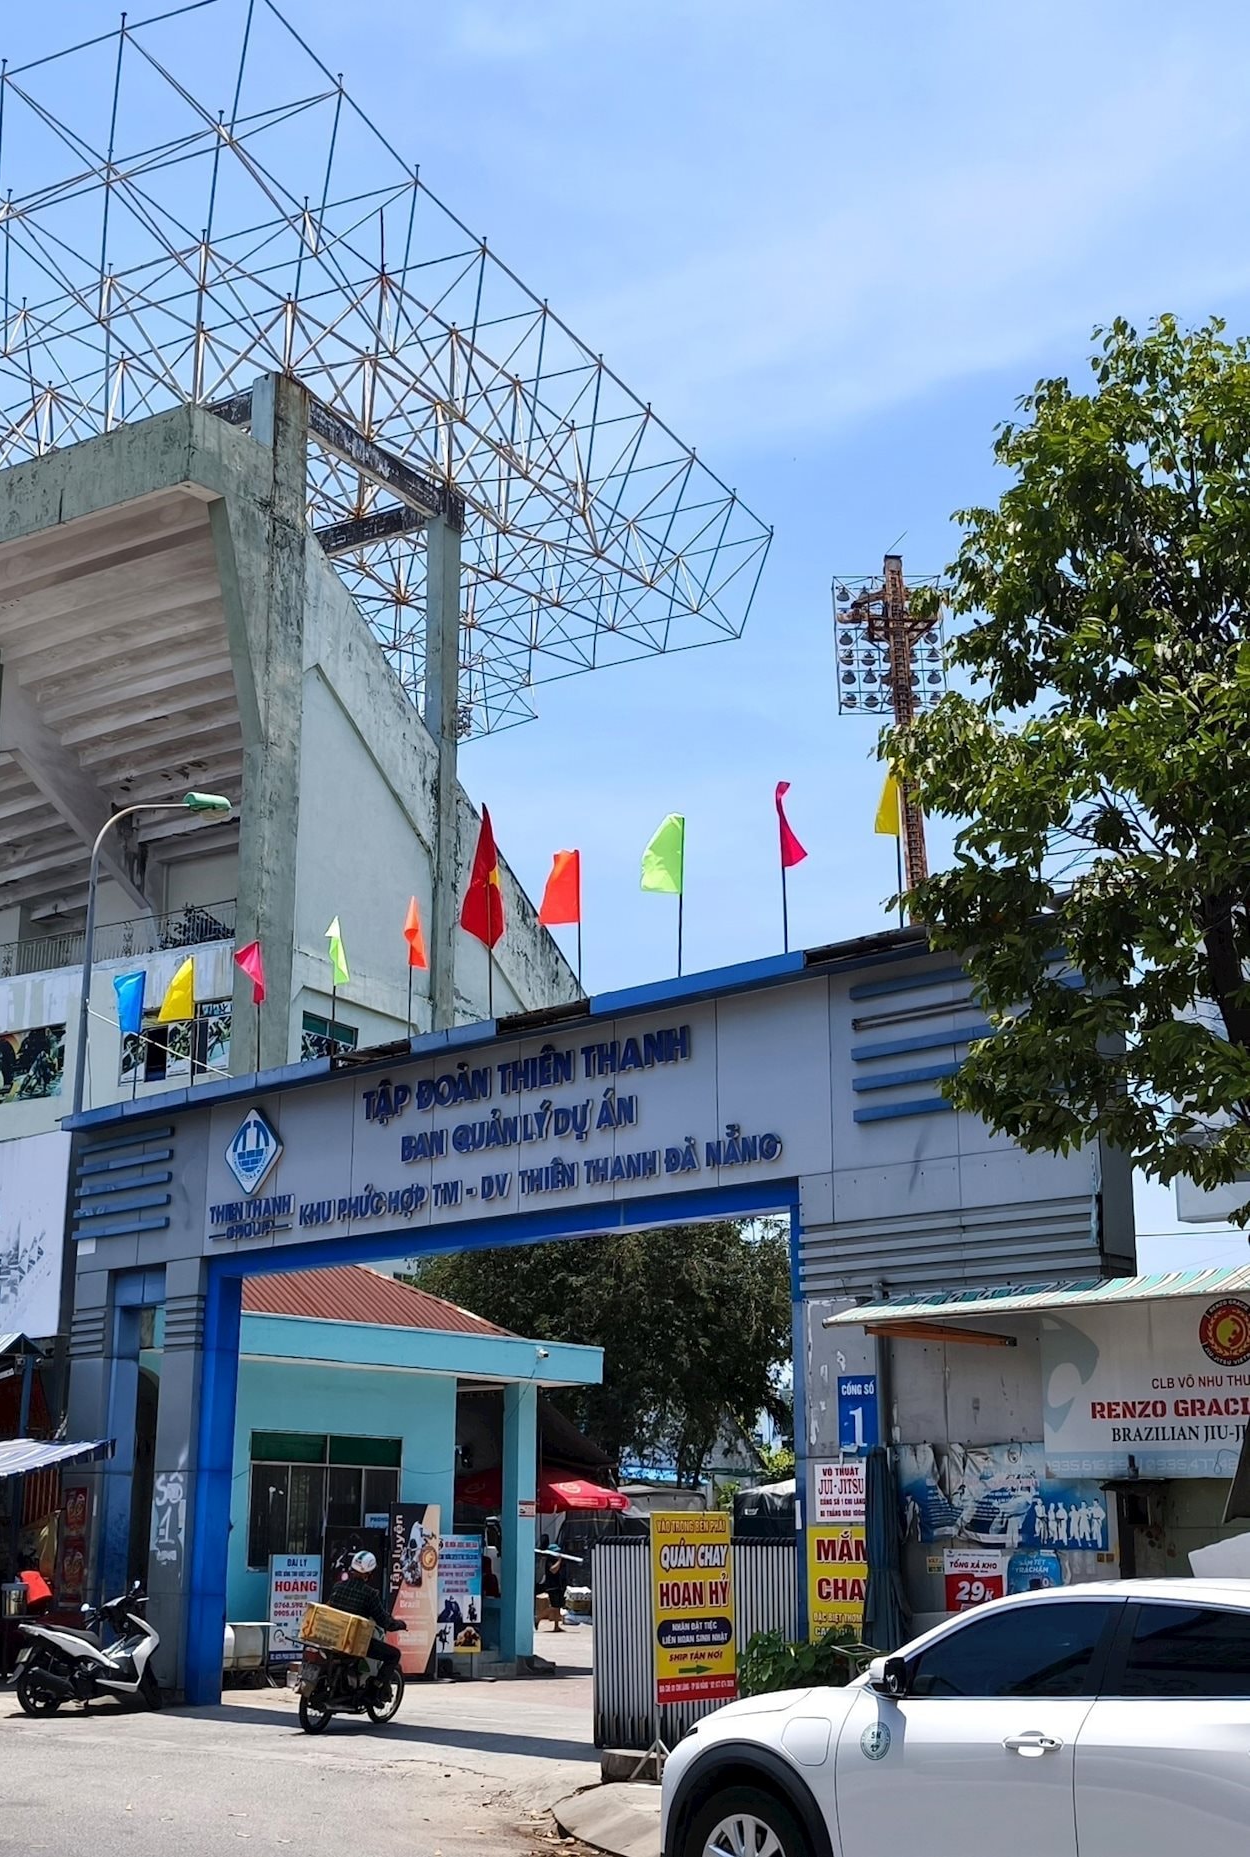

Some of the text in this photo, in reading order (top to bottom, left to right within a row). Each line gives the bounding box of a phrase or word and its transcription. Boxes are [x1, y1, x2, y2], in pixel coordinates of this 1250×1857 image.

[362, 1024, 691, 1125] TẬP ĐOÀN THIÊN THANH
[401, 1087, 638, 1164] BAN QUẢN LÝ DỰ ÁN
[299, 1199, 336, 1228] KHU
[337, 1183, 387, 1221] PHỨC
[387, 1182, 428, 1219] HỢP
[432, 1180, 463, 1207] TM
[481, 1172, 512, 1200] DV
[518, 1156, 579, 1195] THIÊN
[583, 1149, 661, 1185] THANH
[664, 1135, 700, 1176] ĐÀ
[705, 1124, 783, 1170] NẴNG
[247, 1194, 295, 1220] THANH
[863, 1380, 875, 1395] SỐ
[1152, 1377, 1175, 1390] CLB
[1177, 1374, 1195, 1388] VÕ
[1198, 1375, 1223, 1387] NHU
[1091, 1400, 1167, 1419] RENZO
[849, 1406, 868, 1447] 1
[1112, 1426, 1200, 1442] BRAZILIAN
[660, 1537, 729, 1572] QUÁN CHAY
[274, 1578, 317, 1592] HOÀNG
[659, 1572, 730, 1608] HOAN HỶ
[817, 1577, 867, 1602] CHA
[668, 1652, 688, 1662] SHIP
